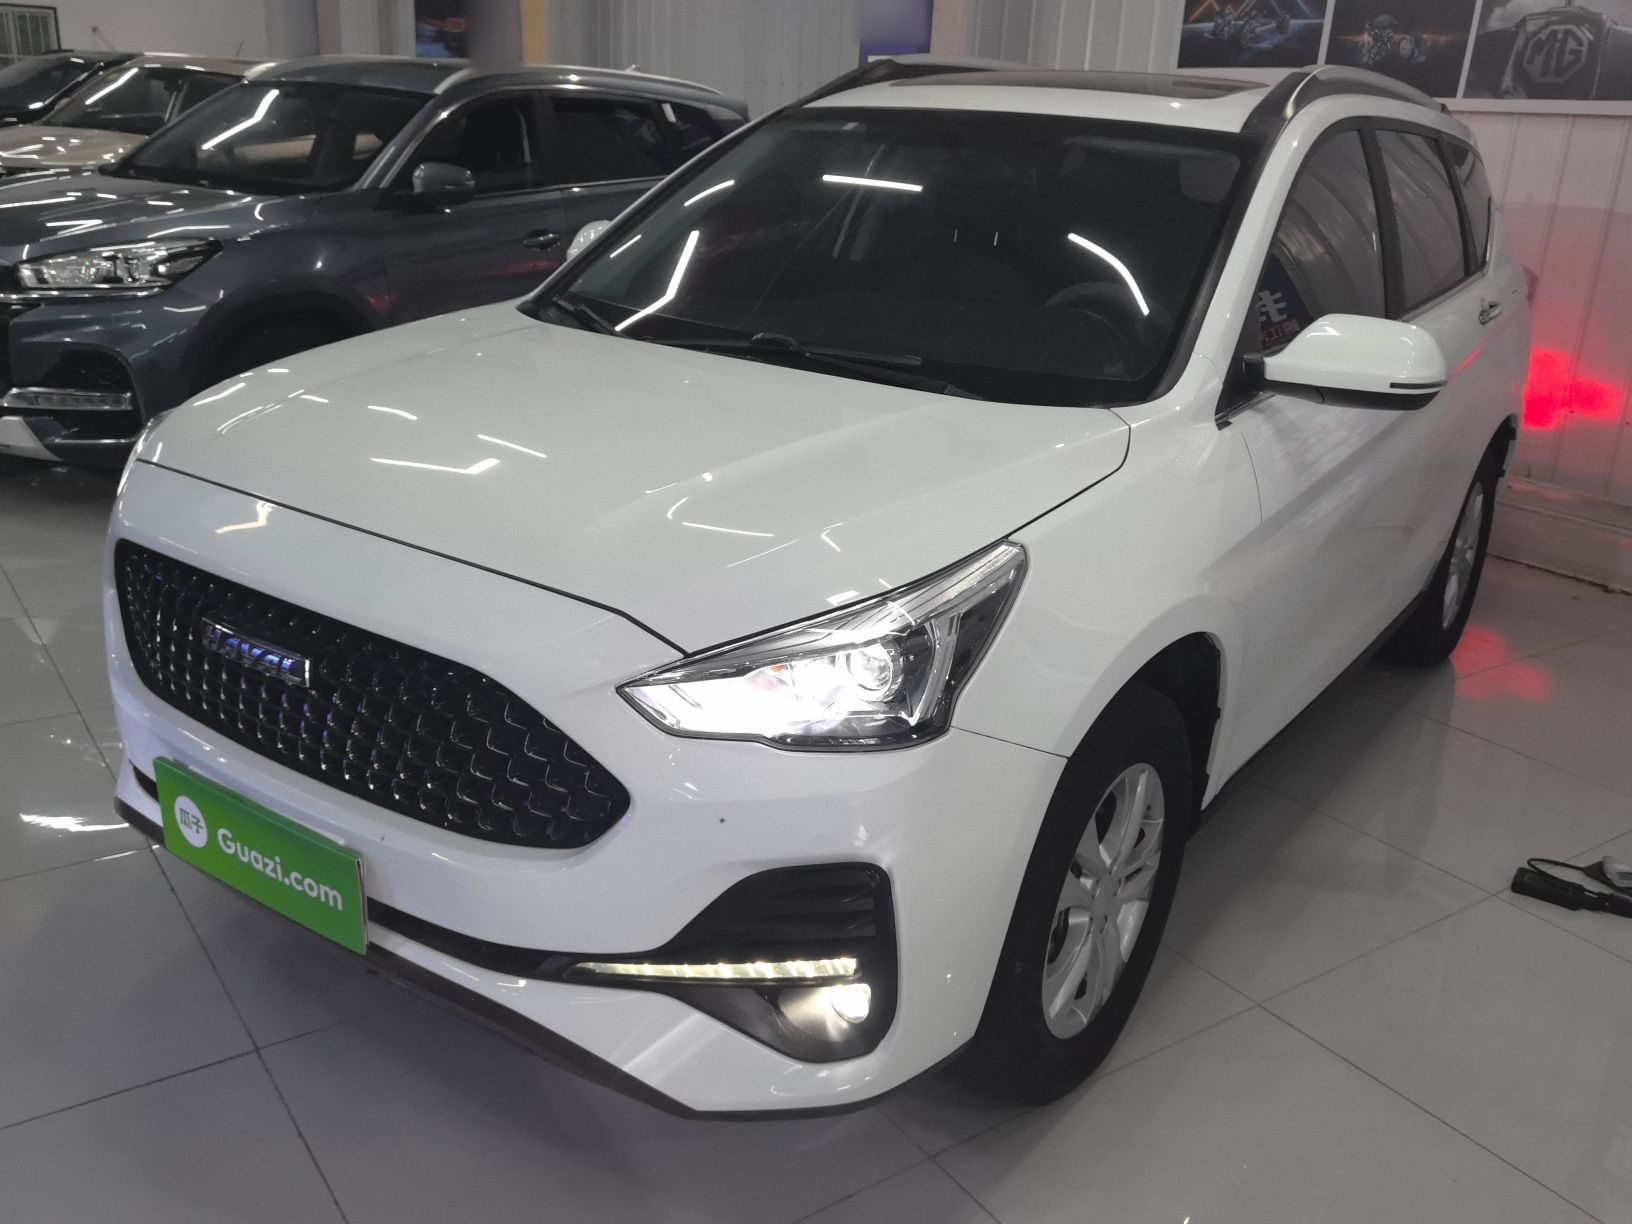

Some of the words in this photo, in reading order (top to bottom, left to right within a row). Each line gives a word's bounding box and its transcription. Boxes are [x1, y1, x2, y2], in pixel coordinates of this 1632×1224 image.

[1526, 27, 1584, 79] MG
[179, 807, 204, 834] 瓜子
[217, 827, 343, 911] Guazi.com
